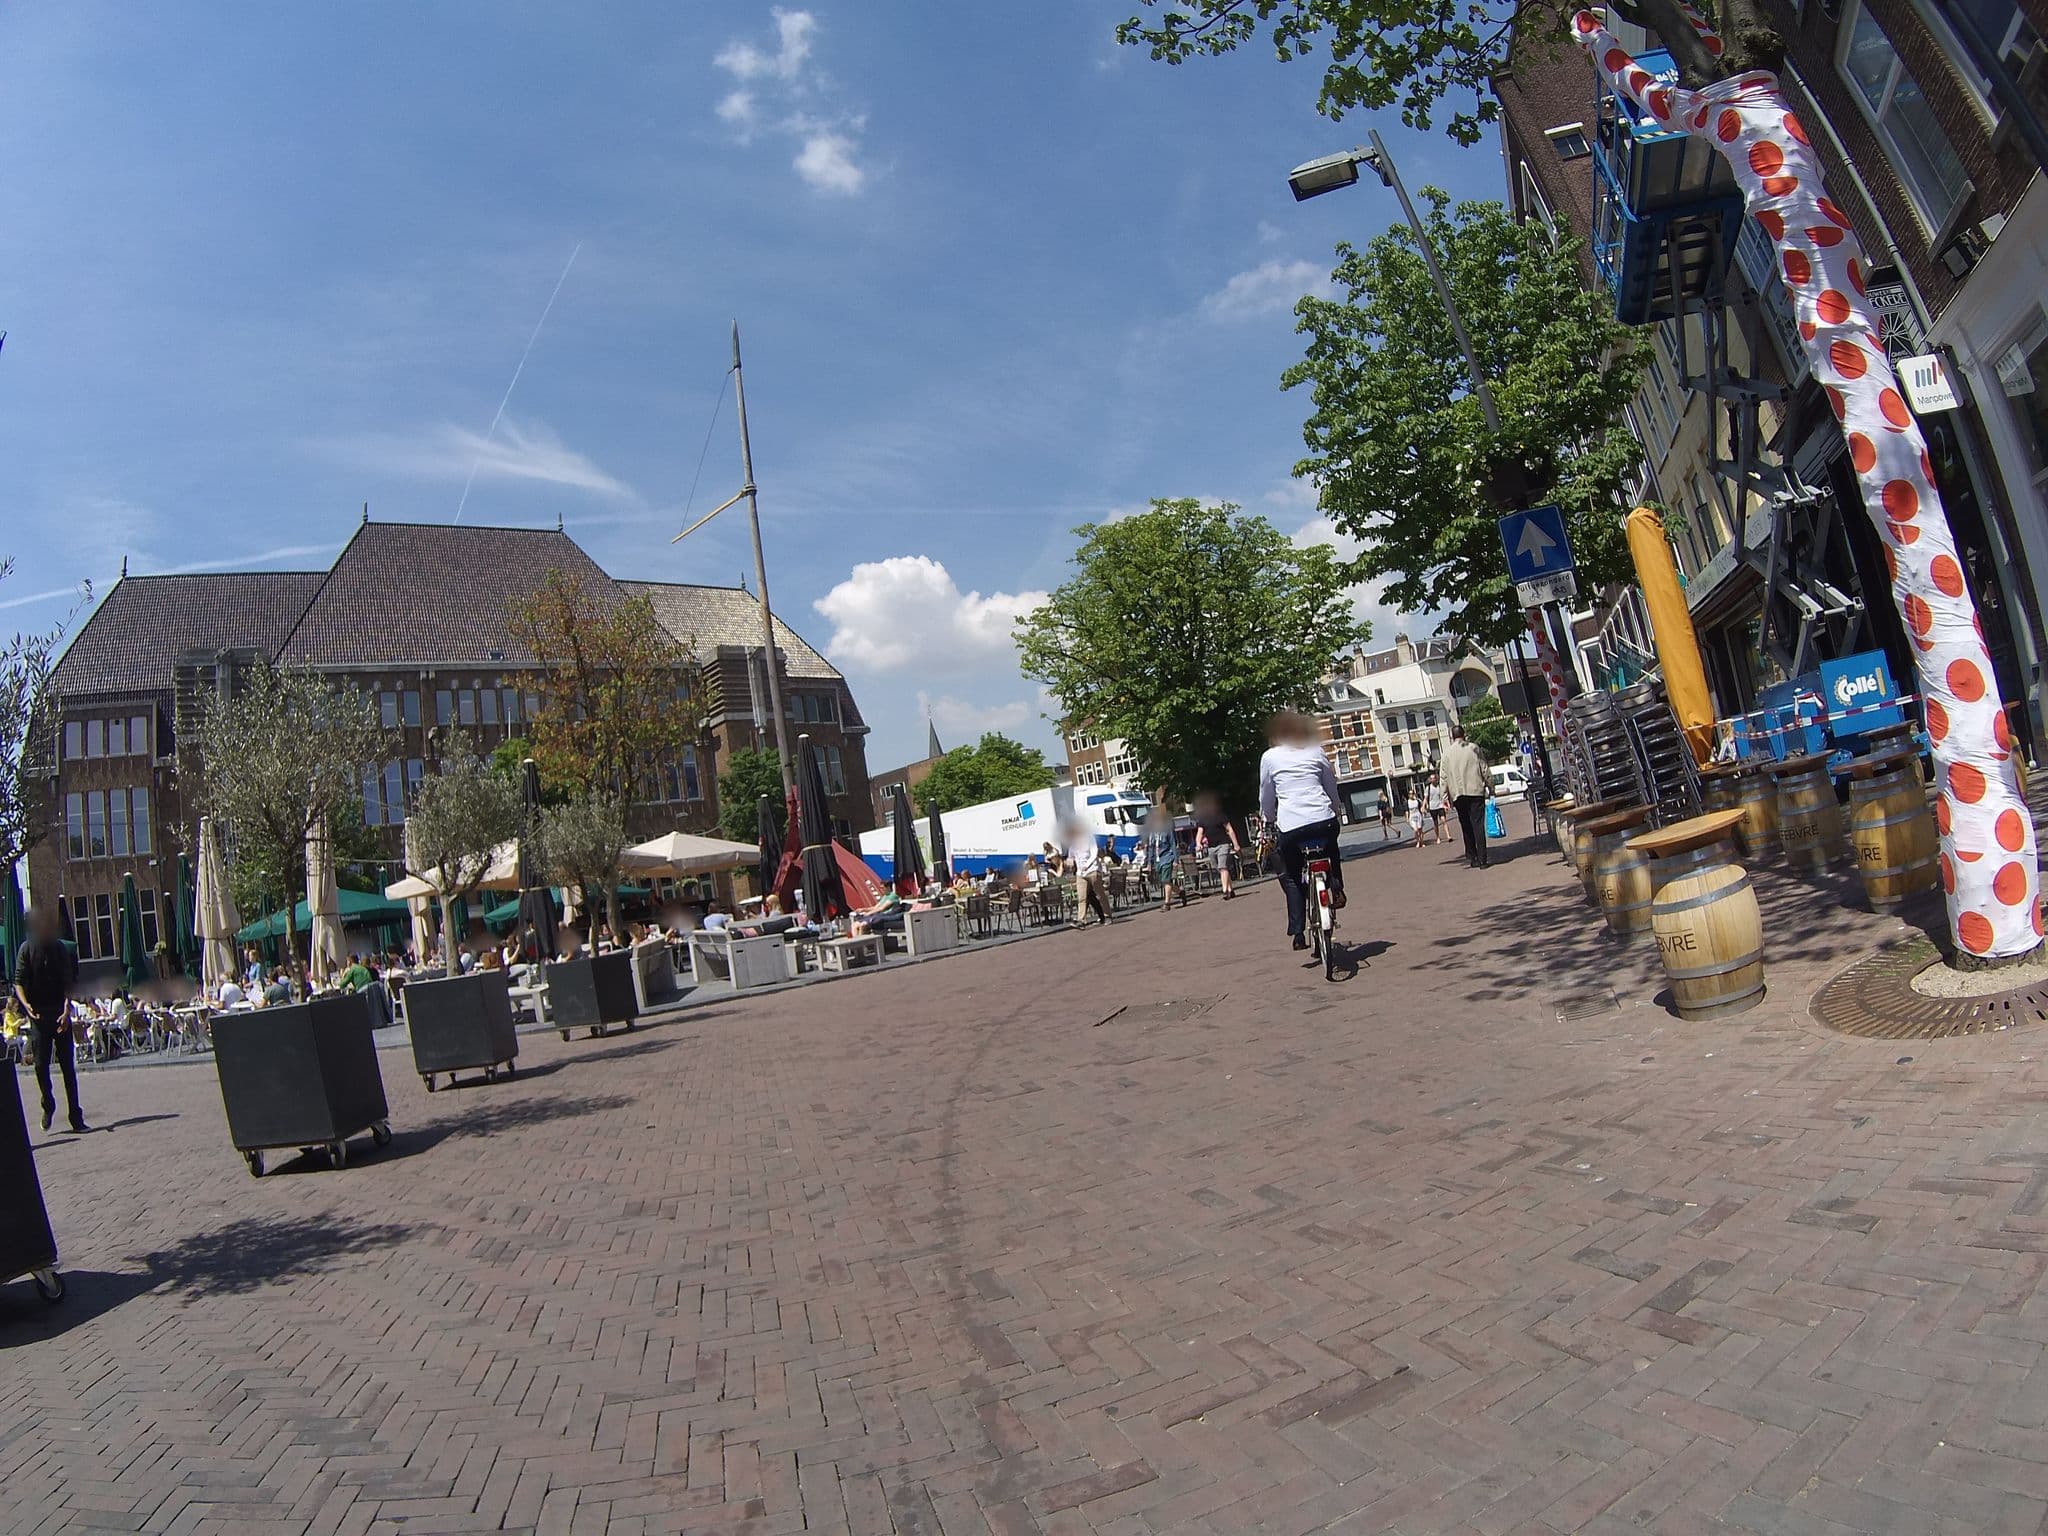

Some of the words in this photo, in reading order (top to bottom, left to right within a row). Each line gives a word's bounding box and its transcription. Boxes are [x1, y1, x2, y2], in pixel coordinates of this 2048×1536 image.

[1917, 393, 1954, 405] Manpowe
[1519, 574, 1570, 592] uitgezonderd
[1835, 673, 1878, 705] Collé
[1001, 815, 1020, 825] TANJA
[1002, 821, 1028, 832] VERHUUR
